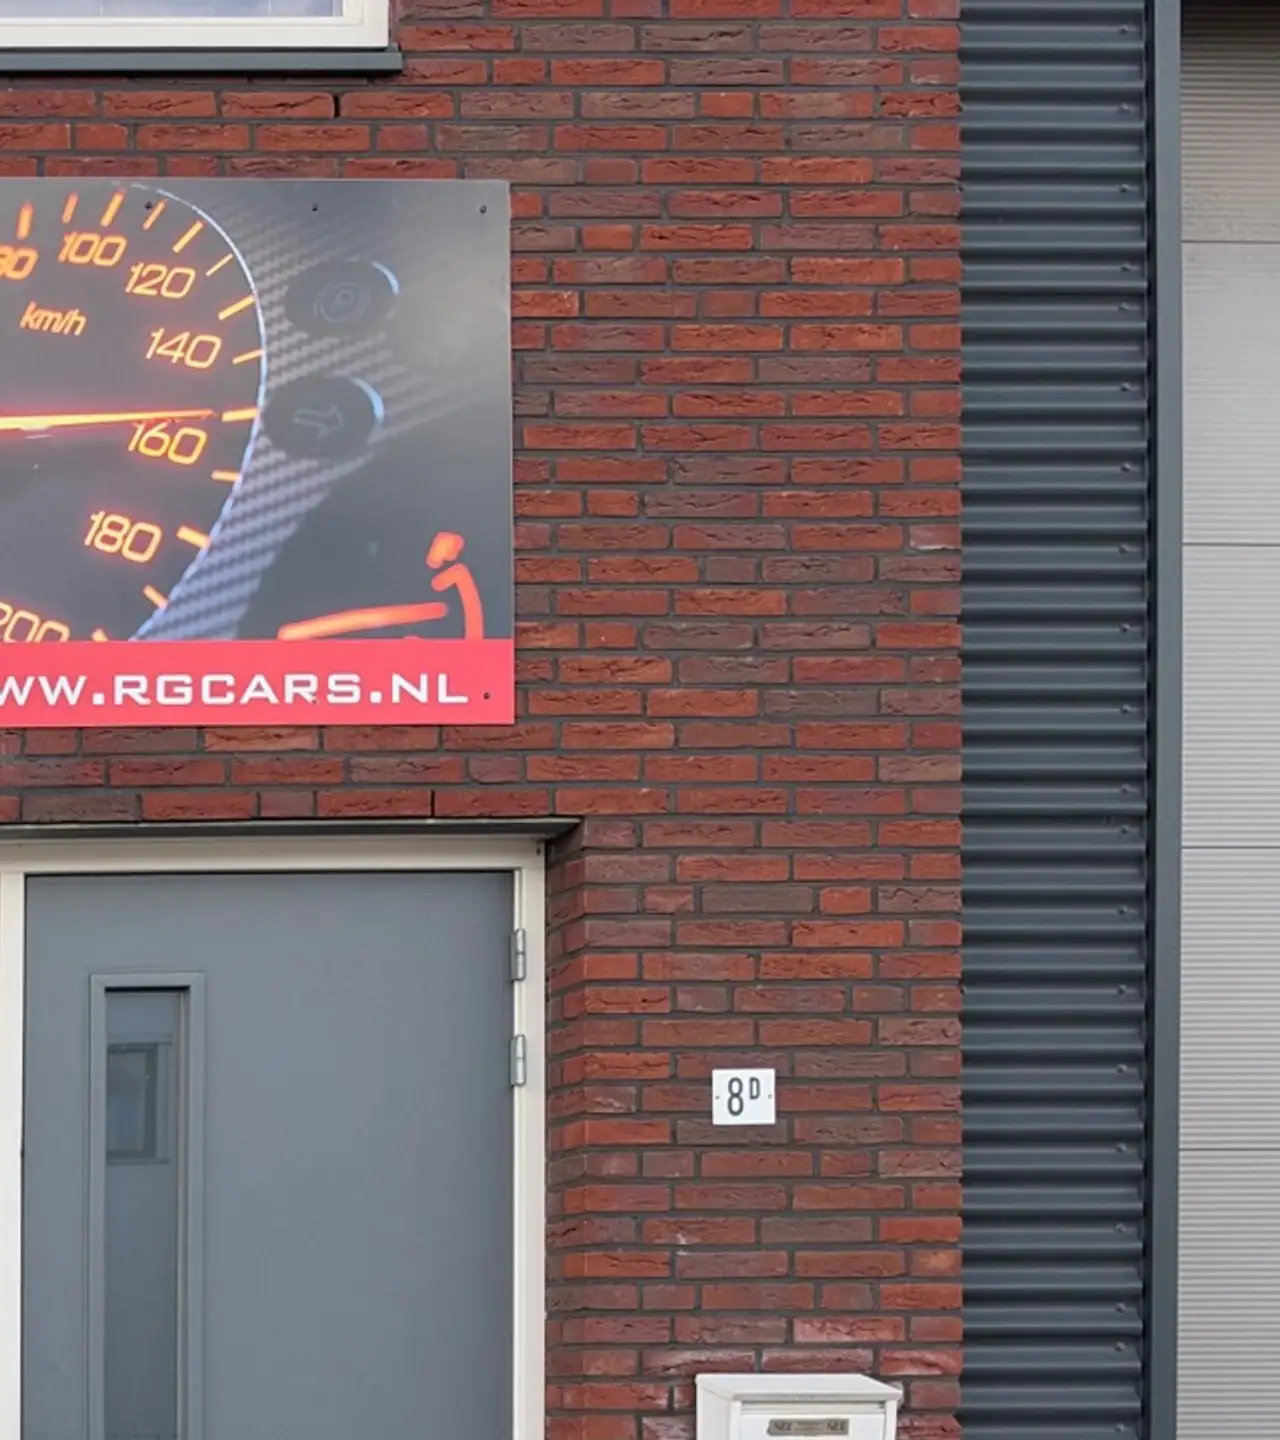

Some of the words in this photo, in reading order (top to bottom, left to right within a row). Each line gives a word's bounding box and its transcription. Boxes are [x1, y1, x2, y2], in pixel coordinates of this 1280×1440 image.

[59, 230, 127, 267] 100
[125, 260, 197, 301] 120
[19, 300, 88, 338] km/h
[144, 326, 222, 370] 140
[126, 418, 208, 466] 160
[83, 508, 163, 564] 180
